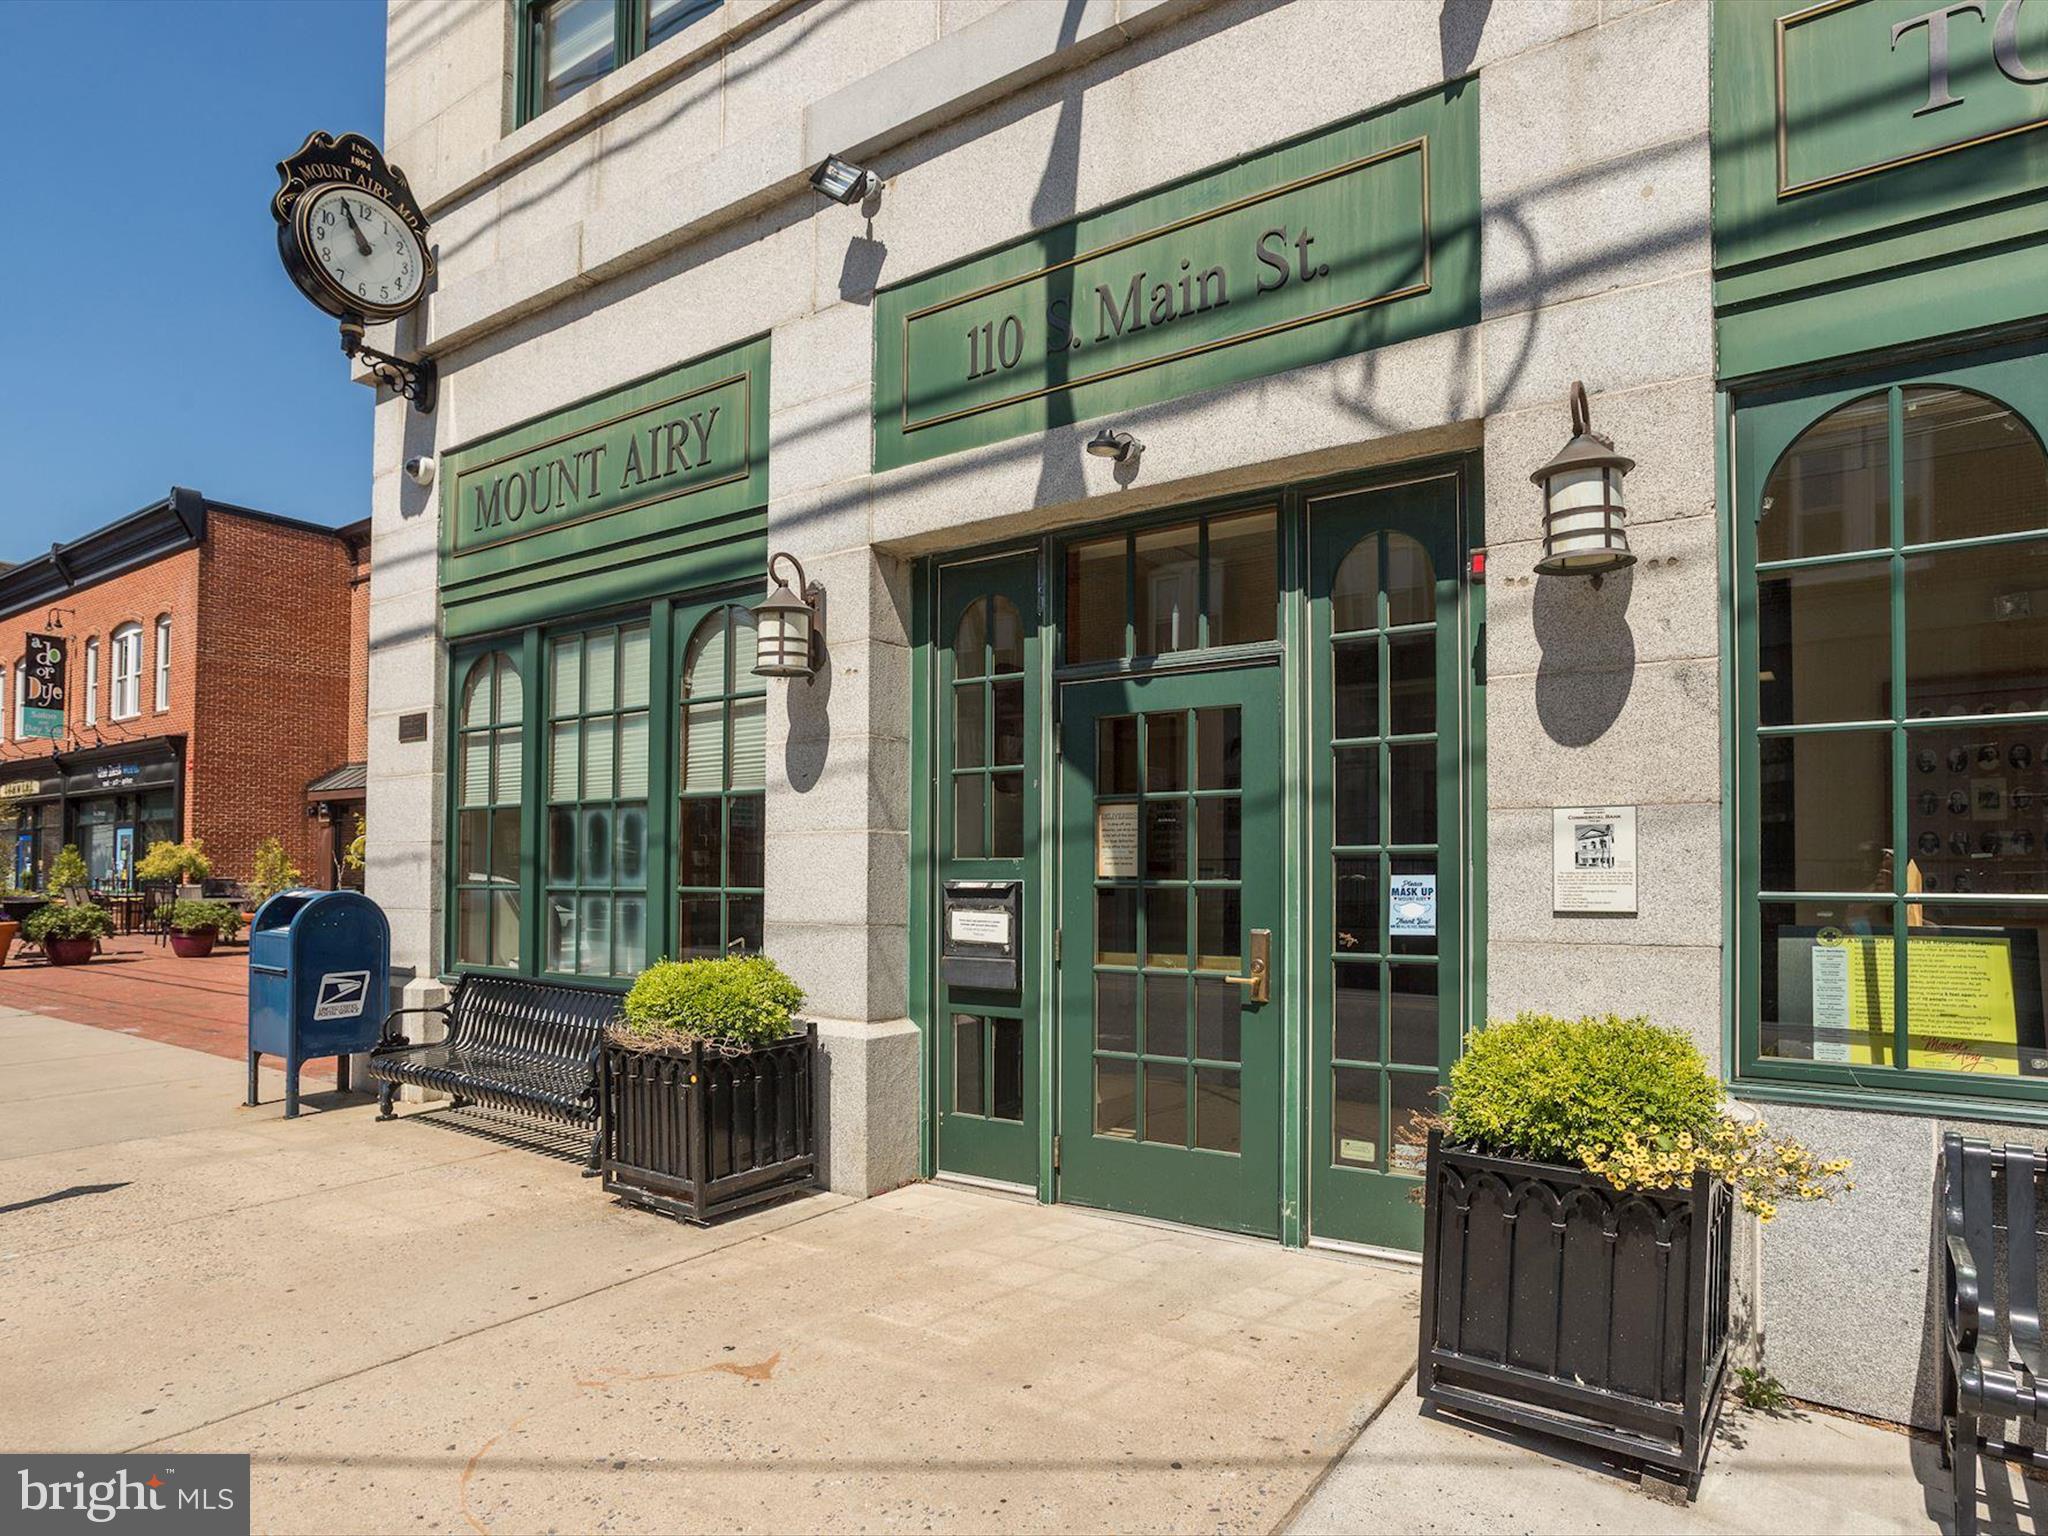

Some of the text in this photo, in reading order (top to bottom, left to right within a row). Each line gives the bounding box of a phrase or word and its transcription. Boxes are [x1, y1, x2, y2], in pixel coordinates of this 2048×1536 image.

[350, 156, 372, 172] 1894
[298, 163, 351, 182] MOUNT
[356, 174, 393, 200] AIRY
[321, 209, 336, 226] 10
[359, 205, 373, 221] 12
[316, 226, 325, 240] 9
[383, 221, 389, 235] 1
[321, 247, 331, 262] 8
[396, 241, 404, 256] 2
[336, 268, 345, 282] 7
[401, 262, 409, 275] 3
[358, 282, 367, 297] 6
[394, 277, 402, 290] 4
[379, 286, 389, 300] 5
[966, 223, 1331, 381] 110 S. Main St.
[473, 406, 720, 532] MOUNT AIRY
[36, 667, 56, 679] or
[28, 676, 64, 707] Dye
[1391, 887, 1434, 896] MASK UP
[1920, 1035, 1969, 1051] Mount
